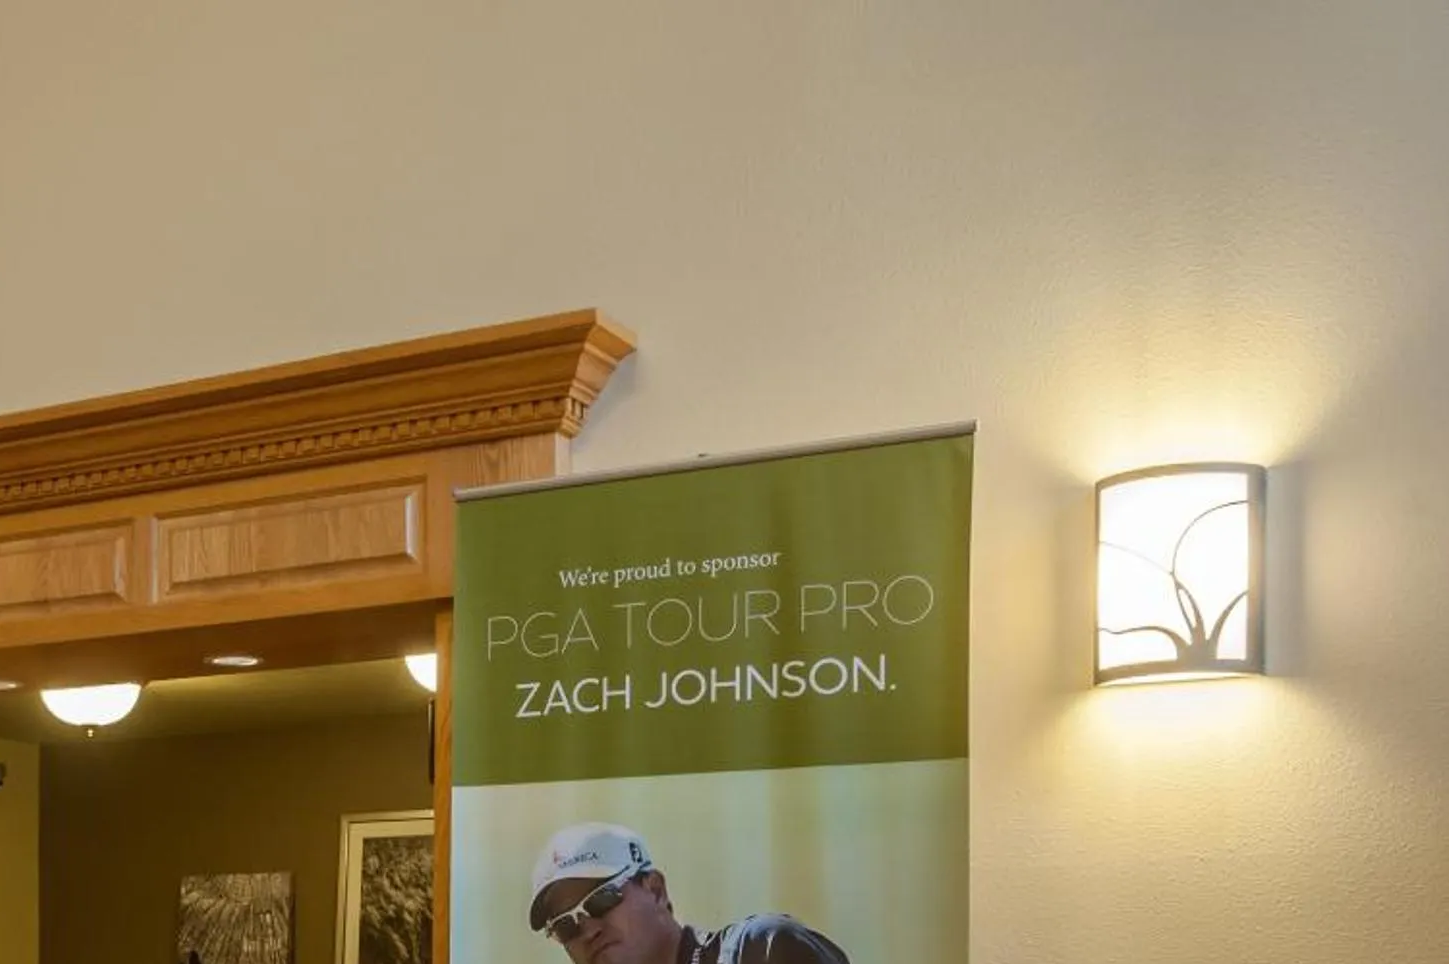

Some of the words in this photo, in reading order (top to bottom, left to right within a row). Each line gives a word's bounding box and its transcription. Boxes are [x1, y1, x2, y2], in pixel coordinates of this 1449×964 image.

[559, 565, 609, 589] We're
[613, 558, 671, 588] proud
[677, 559, 697, 576] to
[701, 552, 782, 578] sponsor
[487, 608, 599, 662] PGA
[613, 590, 781, 649] TOUR
[801, 575, 934, 633] PRO
[515, 674, 631, 718] ZACH
[645, 653, 897, 709] JOHNSON.
